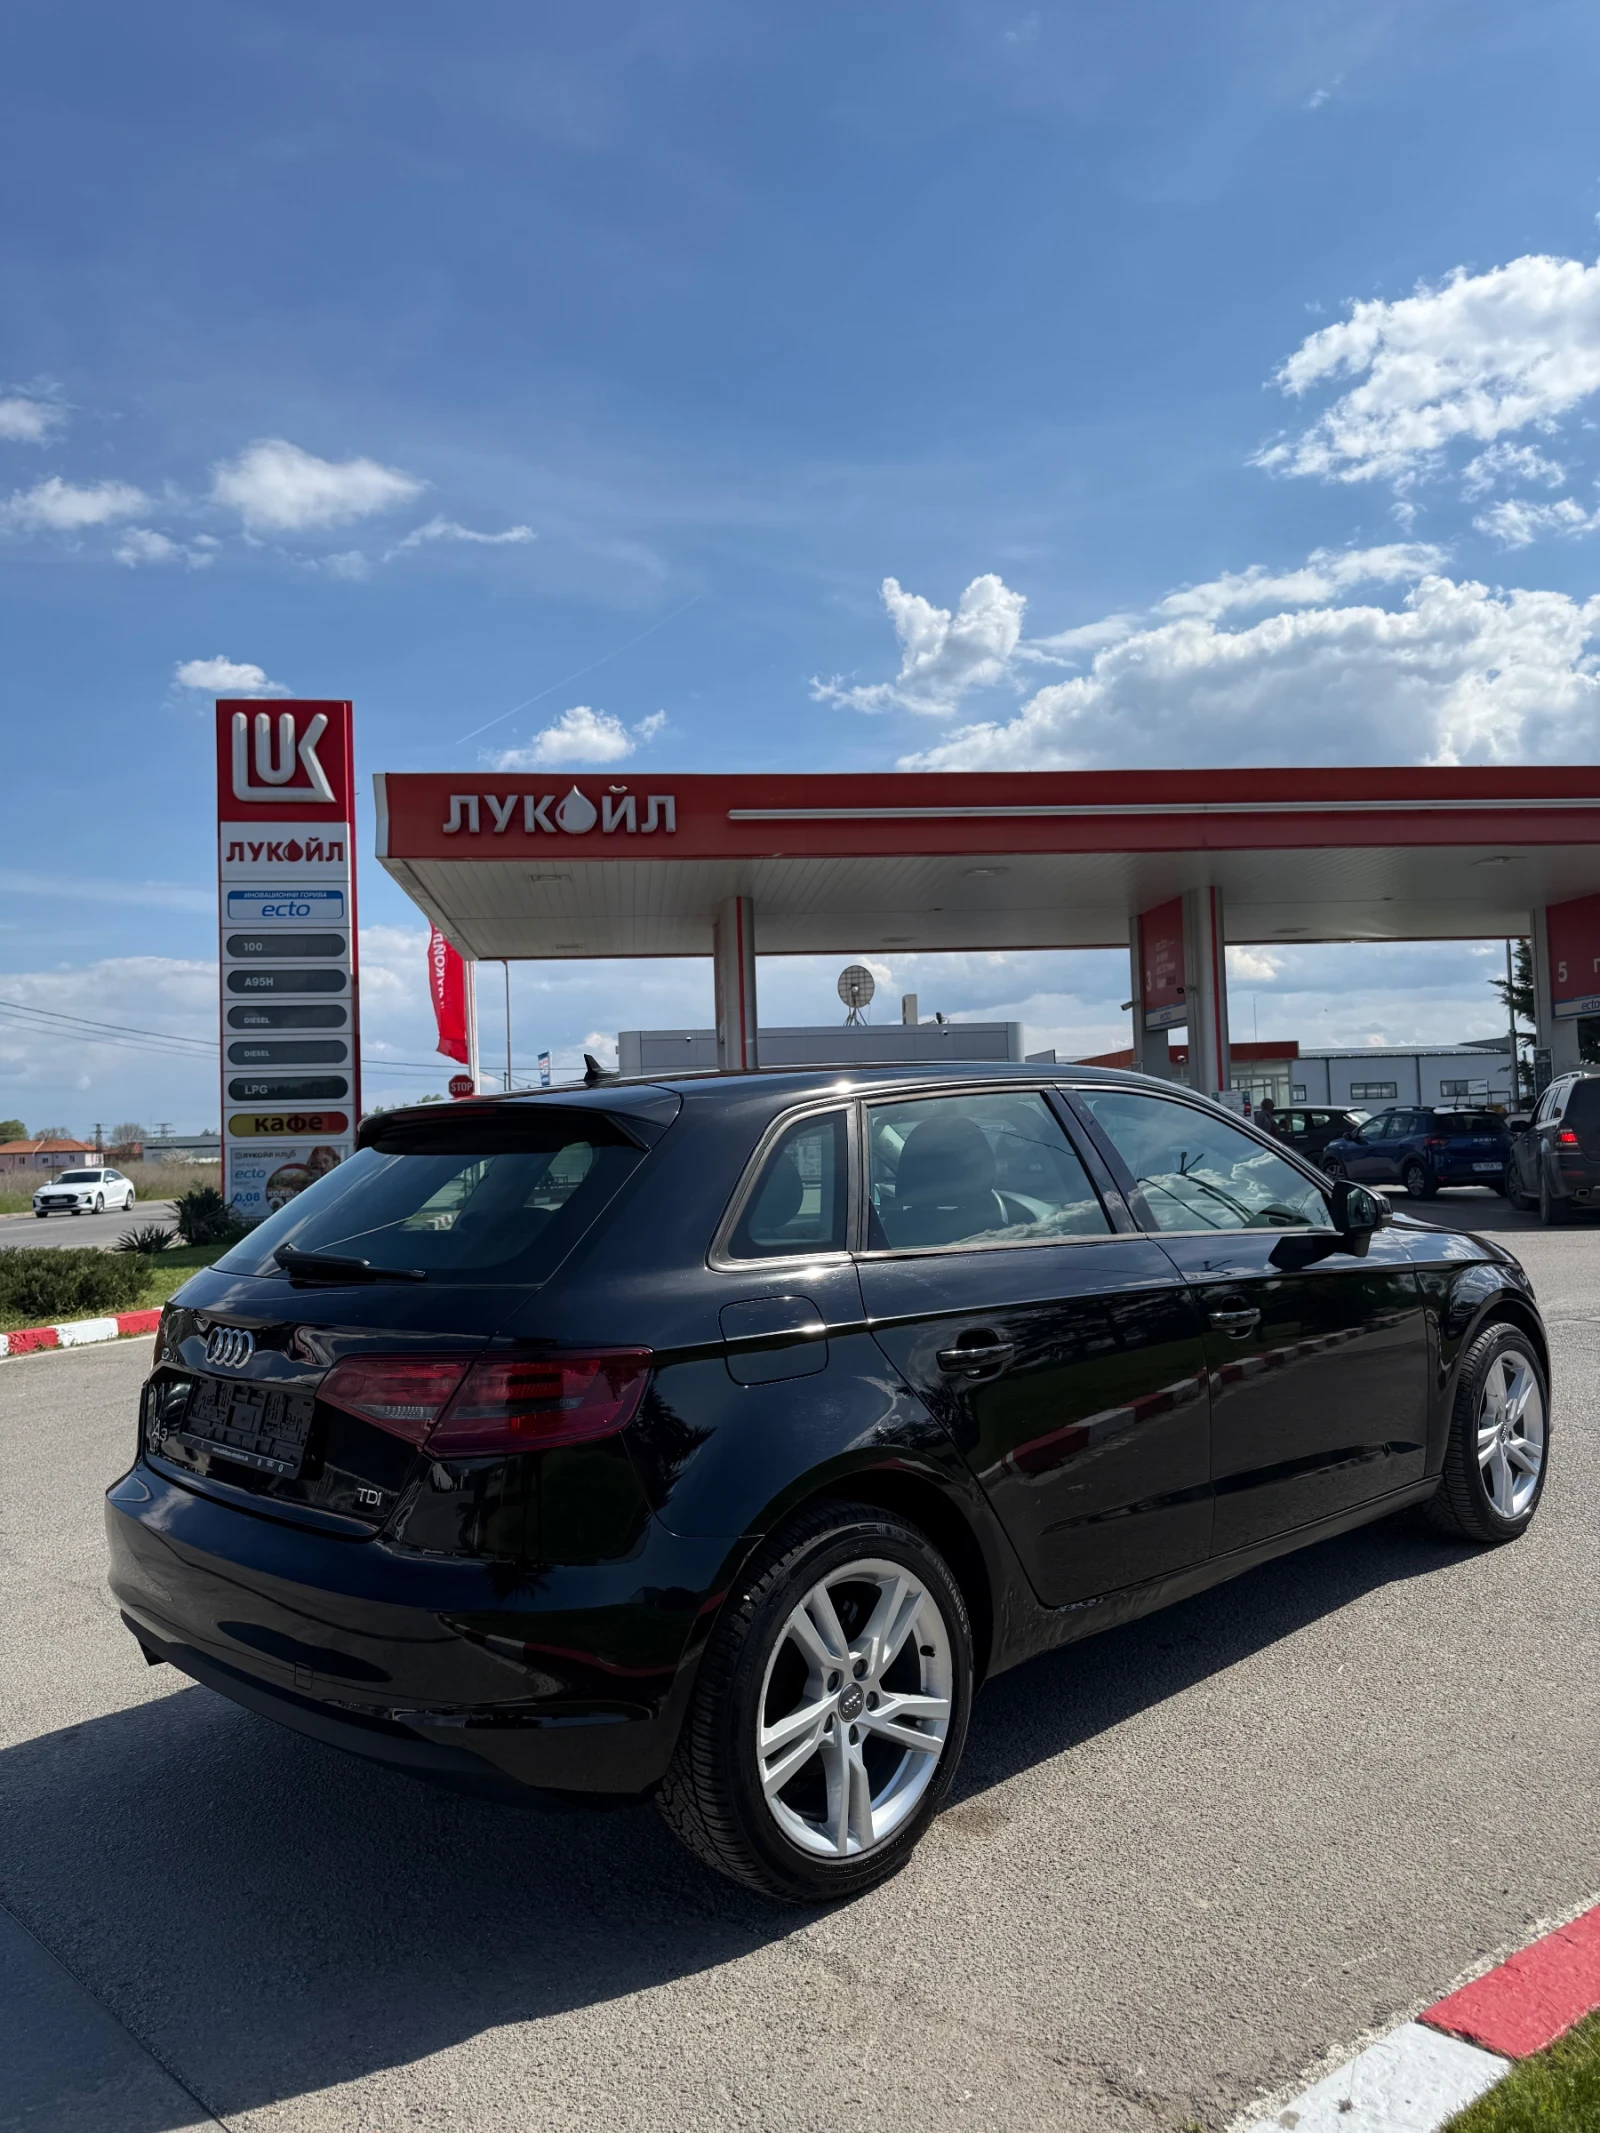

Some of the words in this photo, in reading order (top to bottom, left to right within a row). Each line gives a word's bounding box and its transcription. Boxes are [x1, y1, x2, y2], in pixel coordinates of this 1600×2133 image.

[232, 712, 337, 803] LUK
[443, 785, 677, 834] ЛУКОЙЛ
[226, 837, 344, 862] ЛУКОЙЛ
[262, 901, 311, 917] ecto
[244, 942, 263, 951] 100
[1146, 970, 1152, 992] 3
[1558, 961, 1568, 983] 5
[244, 977, 274, 987] A95H
[245, 1085, 268, 1095] LPG
[450, 1082, 473, 1092] STOP
[235, 1168, 266, 1179] ecto
[151, 1419, 168, 1442] A3
[357, 1487, 382, 1506] TDI
